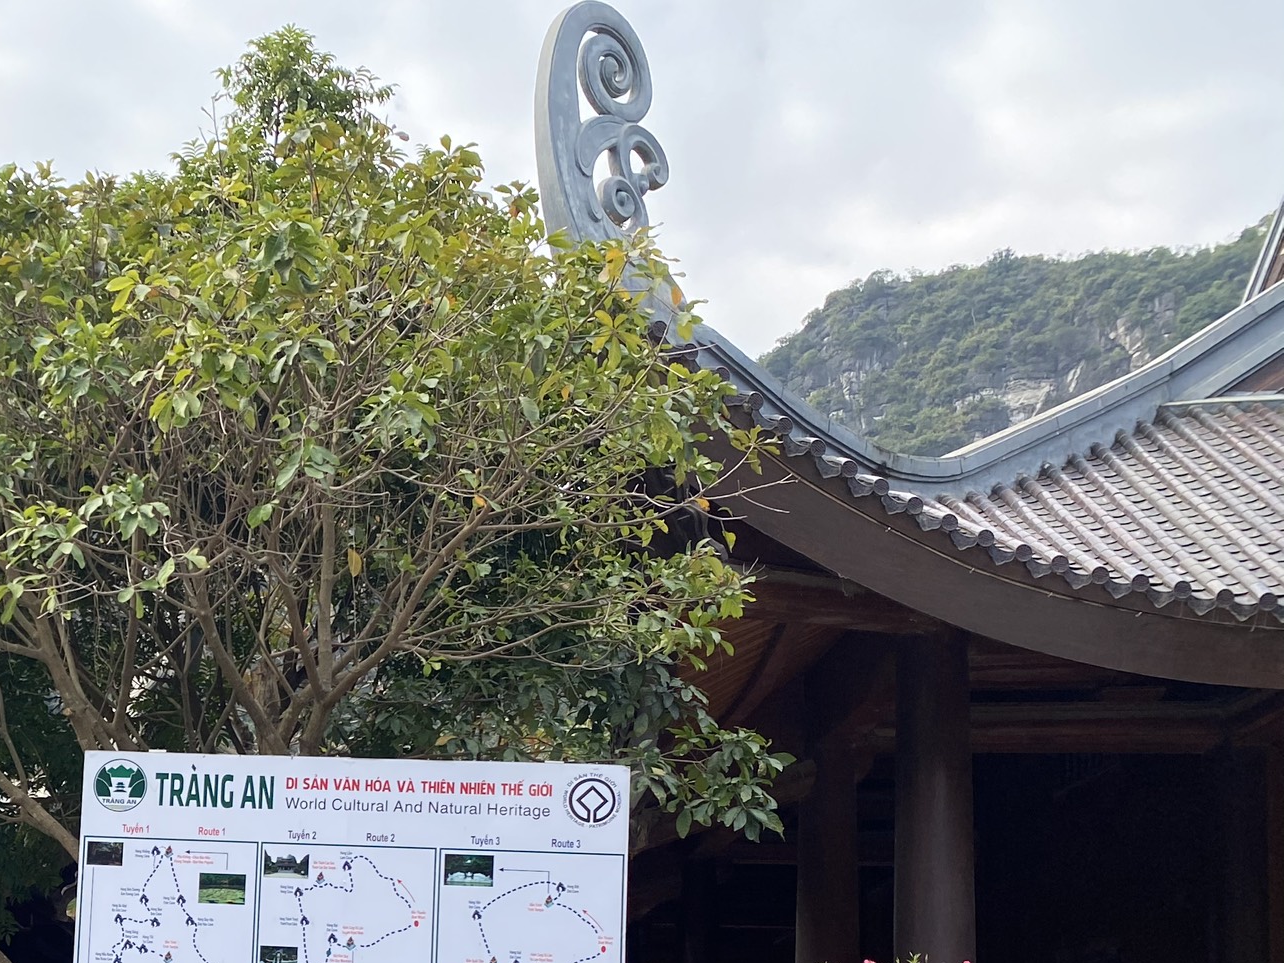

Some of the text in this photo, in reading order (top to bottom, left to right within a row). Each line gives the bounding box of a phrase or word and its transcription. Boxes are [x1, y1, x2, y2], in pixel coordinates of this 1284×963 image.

[156, 764, 275, 810] TRÀNG AN
[286, 774, 553, 797] DI SẢN VĂN HÓA VÀ THIÊN NHIÊN THẾ GIỚI
[285, 796, 551, 820] World Cultural And Natural Heritage
[146, 825, 150, 833] 1
[198, 826, 226, 836] Route 1
[312, 831, 317, 840] 2
[366, 832, 396, 843] Route 2
[496, 836, 500, 846] 3
[552, 838, 581, 849] Route 3
